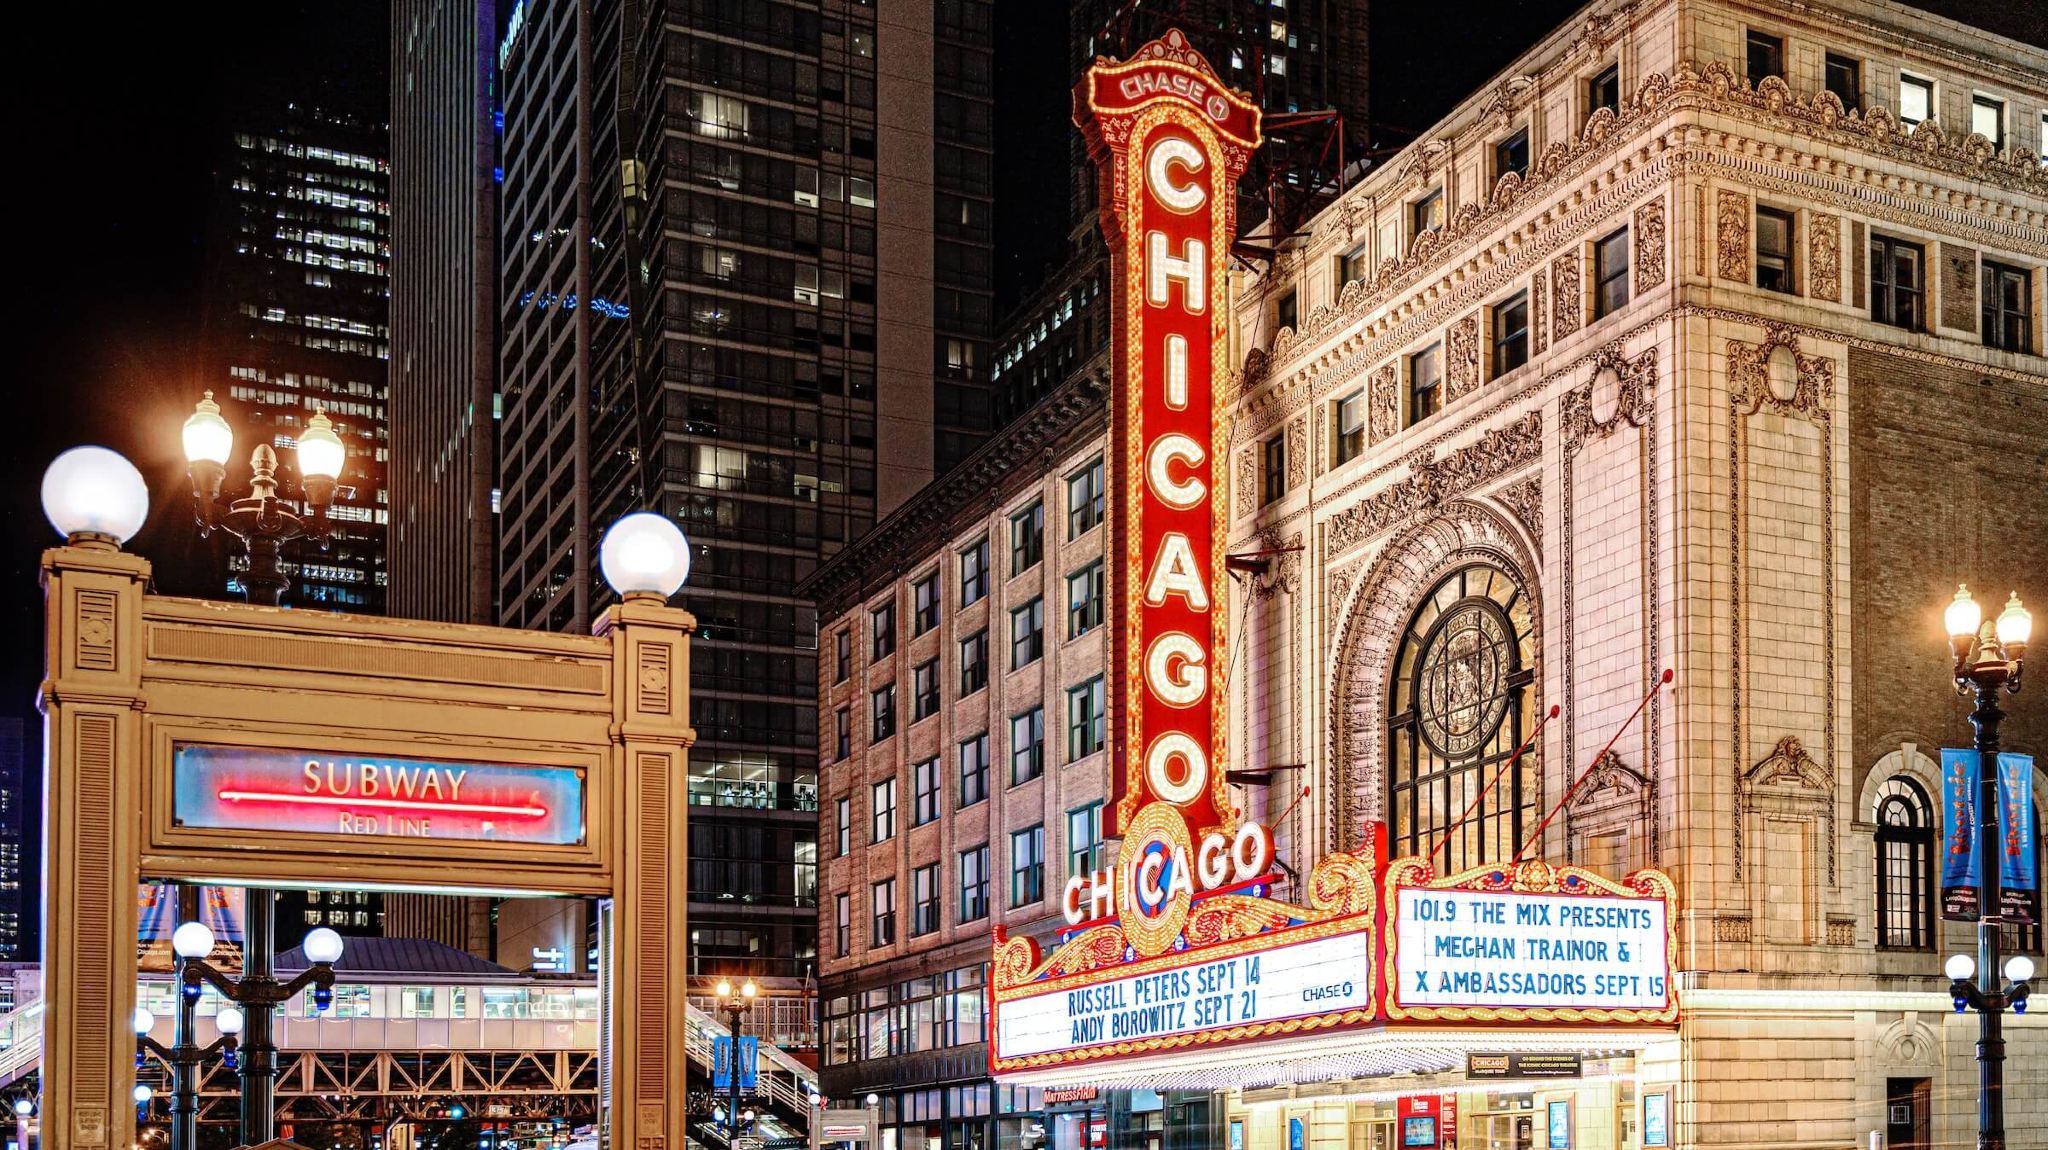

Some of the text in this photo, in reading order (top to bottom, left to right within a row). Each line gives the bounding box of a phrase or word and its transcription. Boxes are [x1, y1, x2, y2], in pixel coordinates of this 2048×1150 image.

[1119, 72, 1207, 106] CHASE
[1144, 137, 1208, 806] CHICAGO
[304, 760, 466, 801] SUBWAY
[1063, 821, 1270, 926] CHICAGO
[1413, 899, 1652, 929] 101.9 THE MIX PRESENTS
[1435, 936, 1630, 963] MEGHAN TRAINOR &
[1068, 956, 1260, 1017] RUSSELL PETERS SEPT 14
[1303, 984, 1341, 1001] CHASE
[1416, 970, 1664, 996] X AMBASSADORS SEPT 15
[1071, 989, 1256, 1044] ANDY BOROWITZ SEPT 21
[1475, 1058, 1505, 1067] CHICAGO
